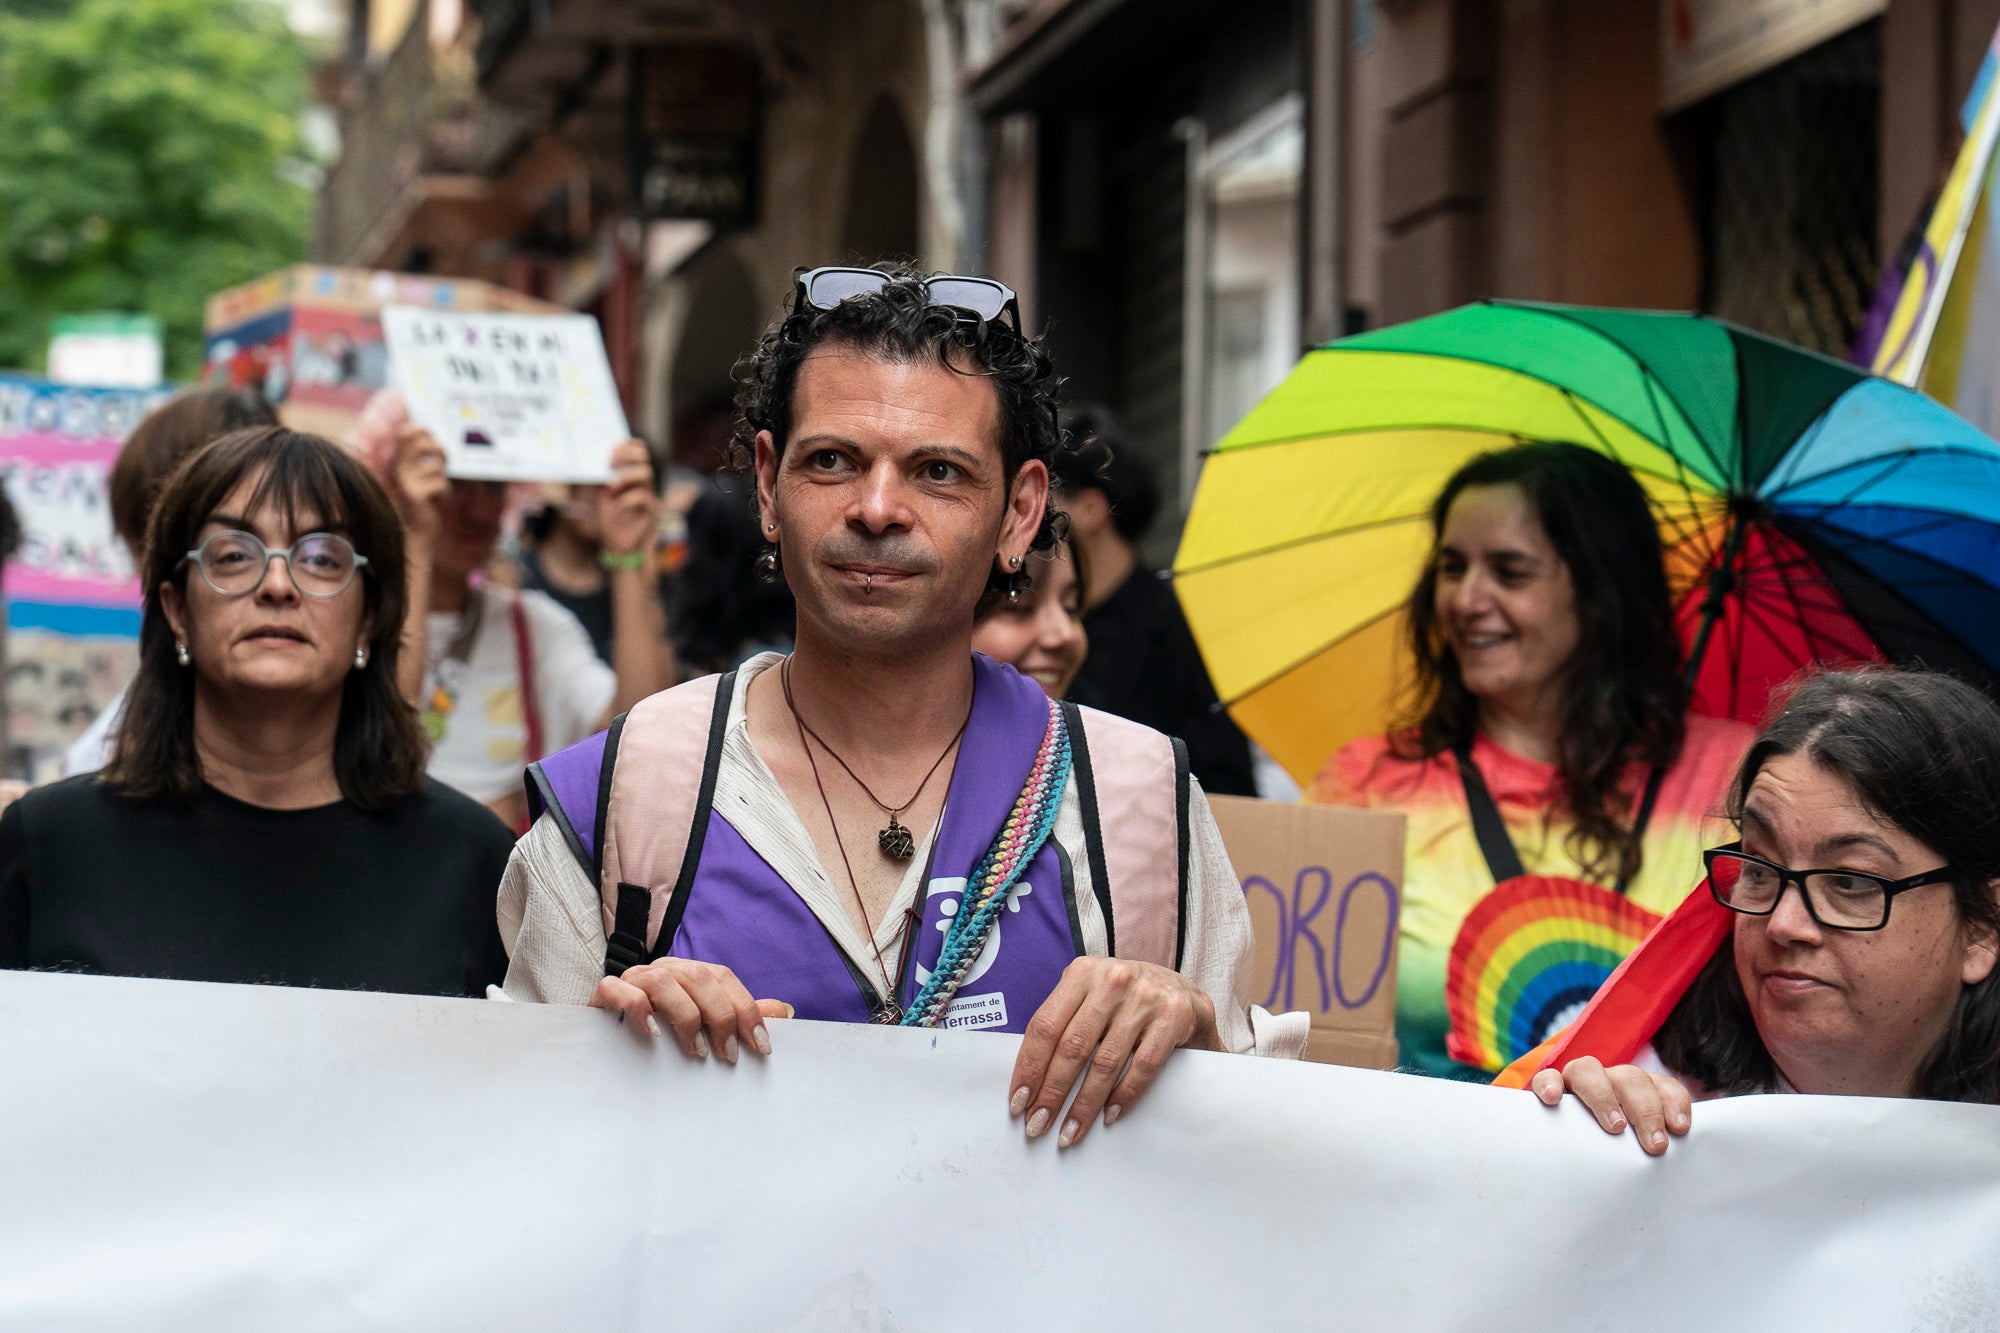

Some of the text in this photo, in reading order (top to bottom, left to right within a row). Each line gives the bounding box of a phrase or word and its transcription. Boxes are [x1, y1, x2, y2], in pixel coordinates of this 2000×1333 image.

[488, 325, 528, 352] EN
[944, 998, 1000, 1015] untament de
[942, 1011, 1003, 1029] Terrassa
